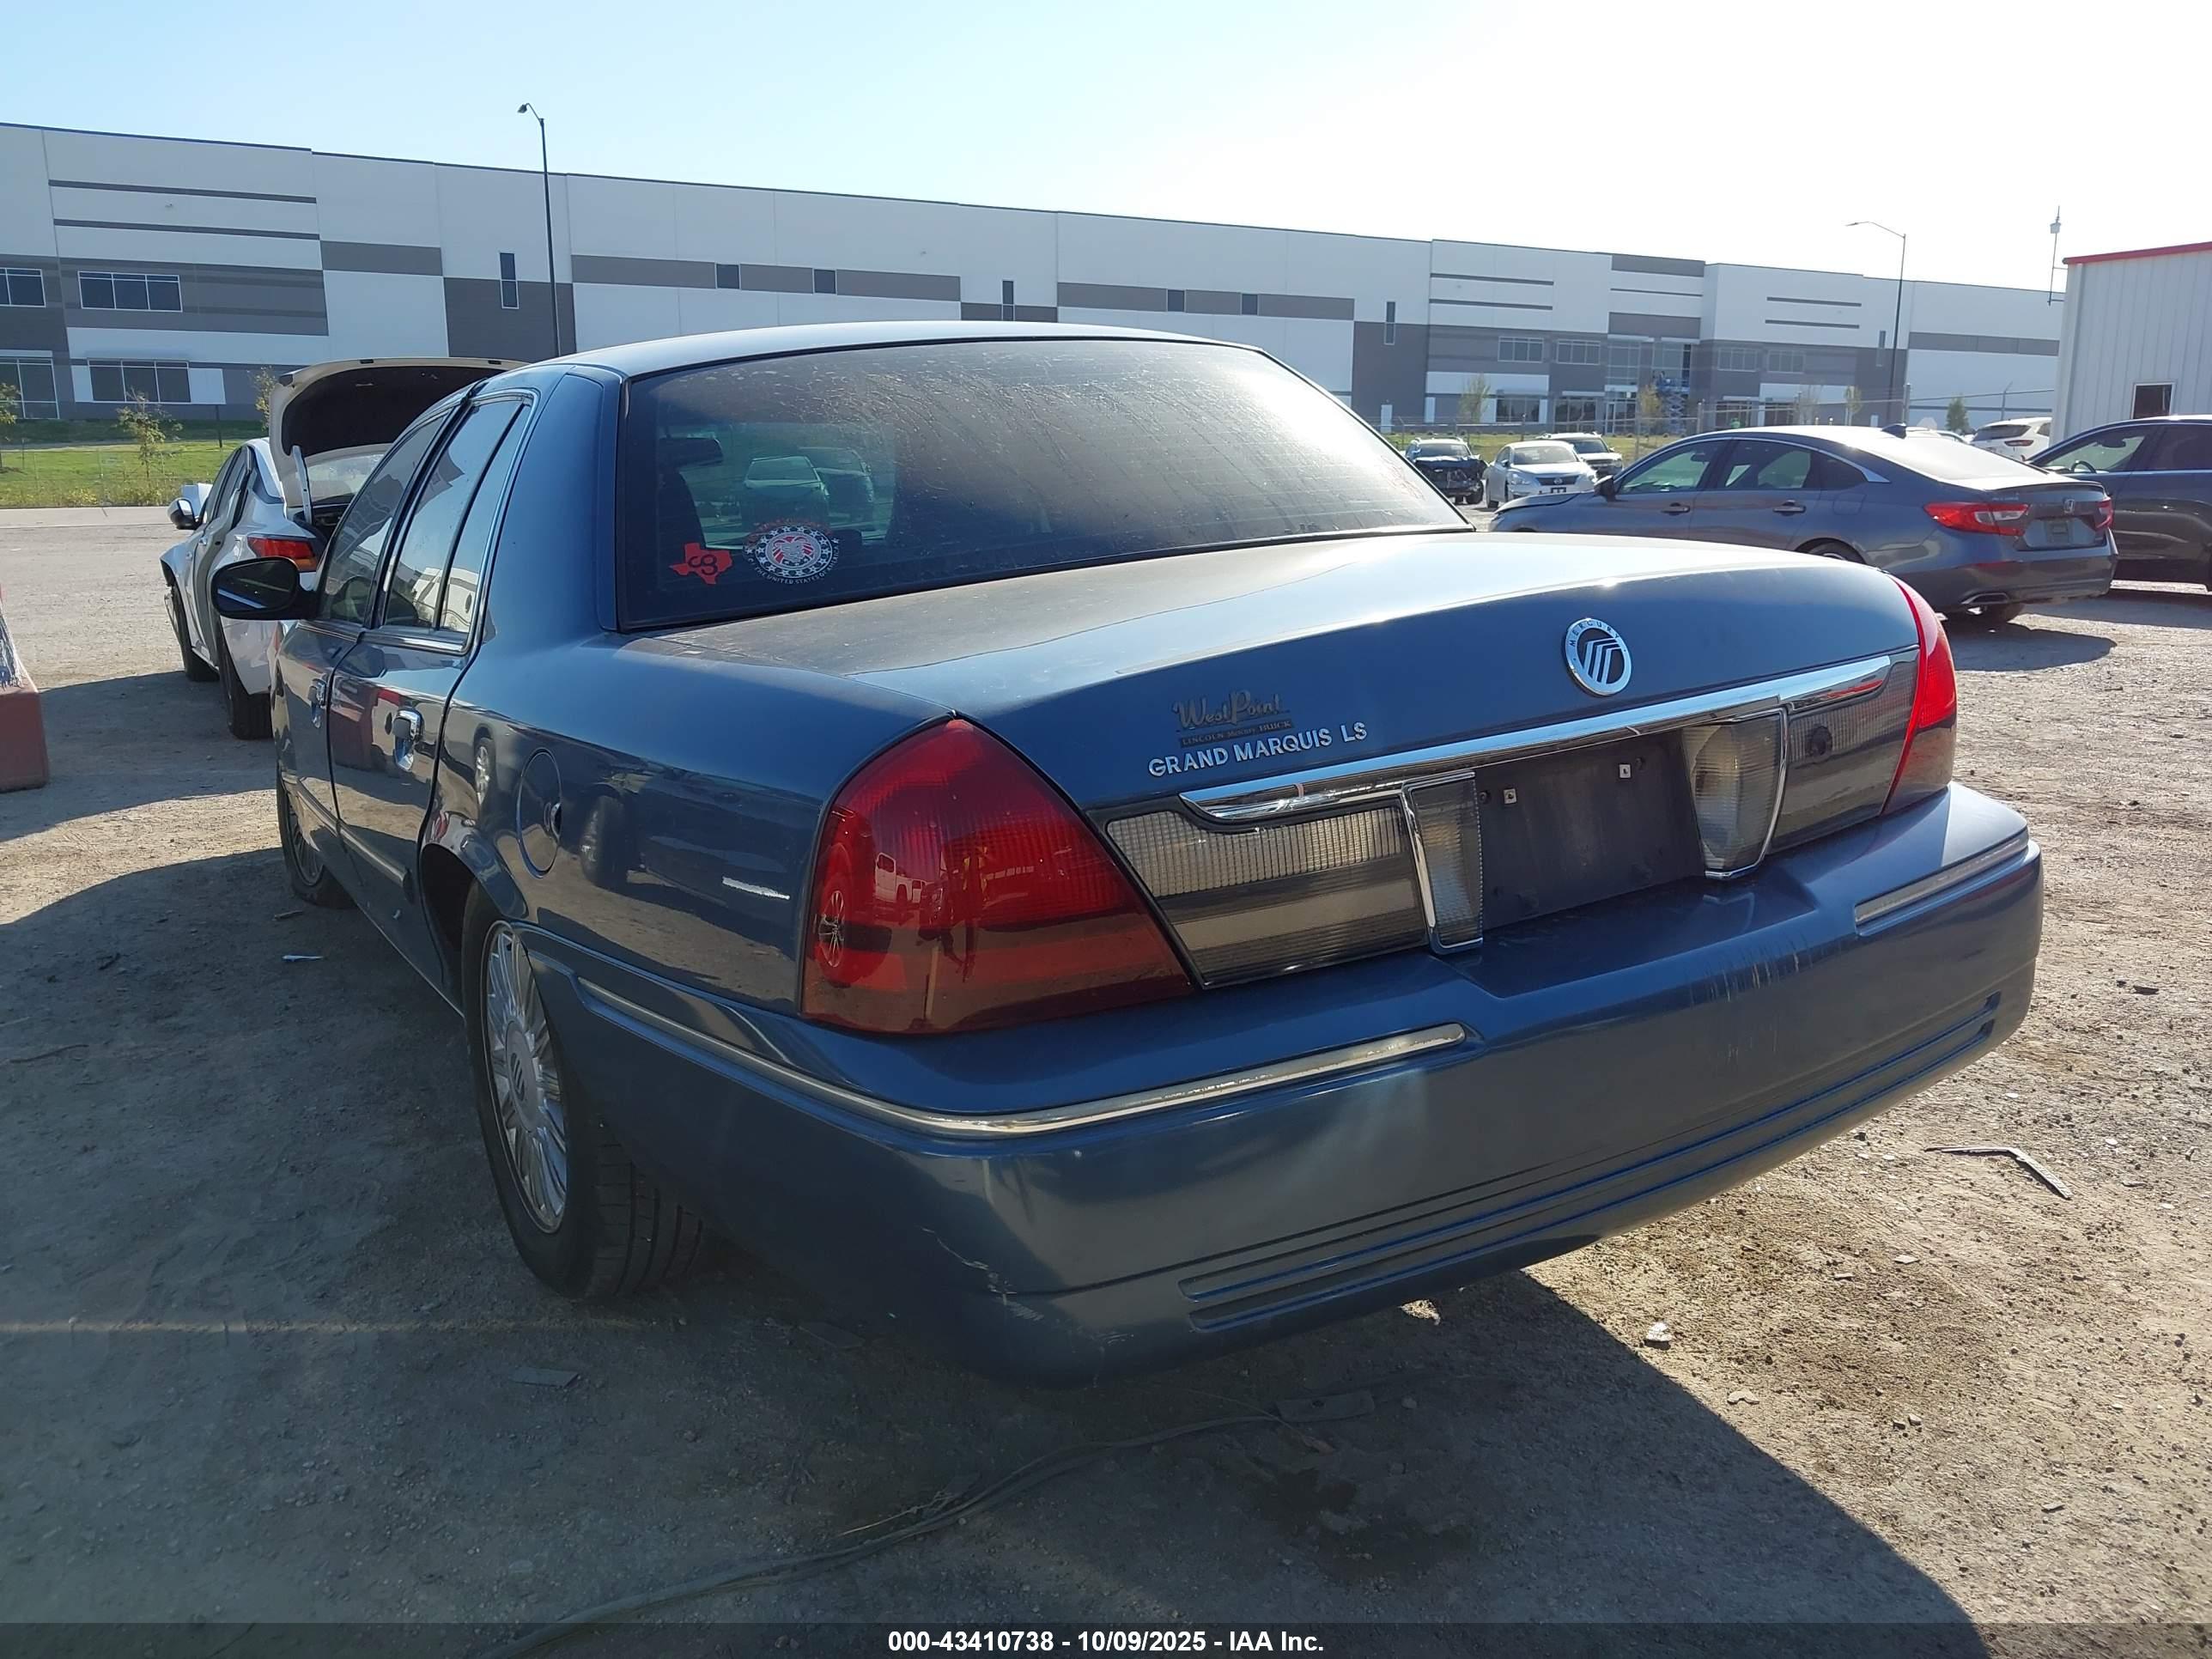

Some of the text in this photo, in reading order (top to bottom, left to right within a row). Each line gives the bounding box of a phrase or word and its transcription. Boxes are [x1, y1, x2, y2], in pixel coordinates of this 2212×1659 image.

[767, 574, 794, 585] UNITED
[795, 574, 820, 585] STATES
[1569, 620, 1620, 647] MERCURY
[1171, 688, 1282, 729] West Point
[1182, 732, 1224, 745] LINCOLN
[1258, 720, 1291, 732] BUICK
[1148, 721, 1368, 777] GRAND MARQUIS LS
